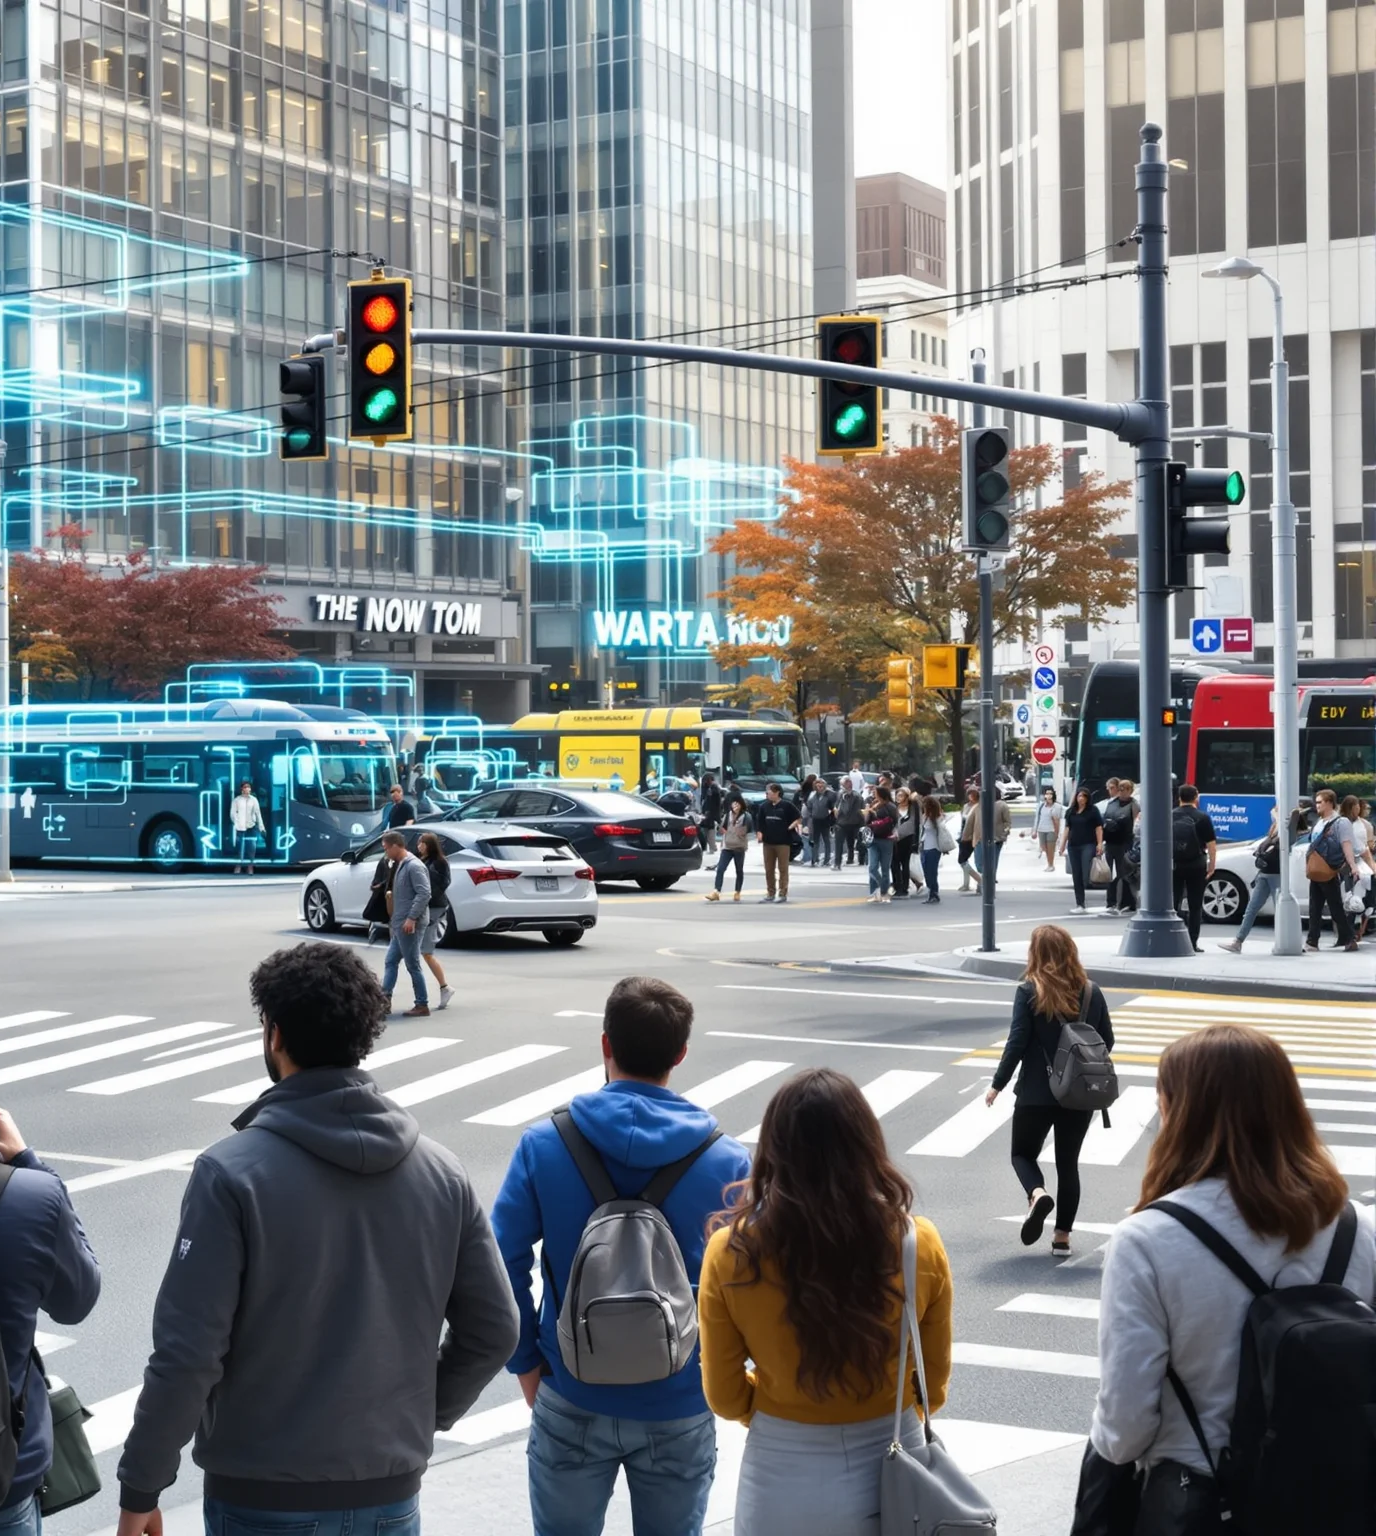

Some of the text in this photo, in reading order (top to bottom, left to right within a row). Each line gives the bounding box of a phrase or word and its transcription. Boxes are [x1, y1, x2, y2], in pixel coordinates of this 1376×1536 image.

[316, 594, 482, 635] THE NOW TOM
[592, 610, 720, 647] WARTA
[1321, 706, 1347, 719] EDY
